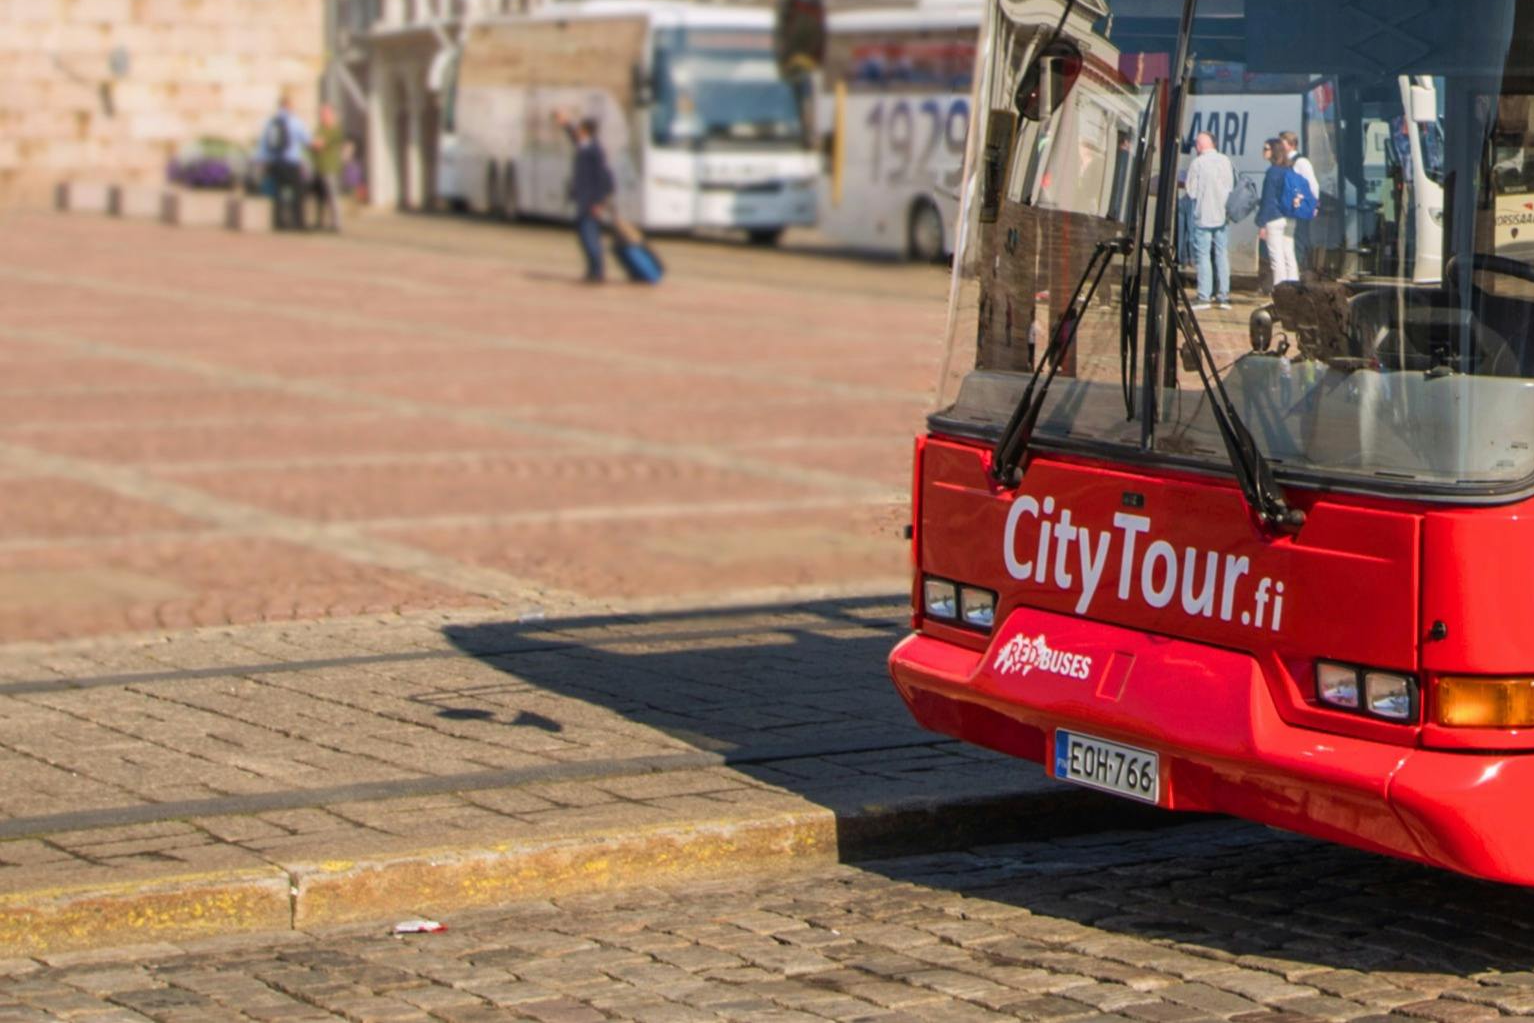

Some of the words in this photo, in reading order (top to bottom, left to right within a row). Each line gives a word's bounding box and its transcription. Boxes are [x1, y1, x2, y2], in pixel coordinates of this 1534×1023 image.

[1003, 494, 1286, 632] CityTour.fi
[1039, 646, 1093, 680] BUSES
[1070, 740, 1153, 793] EOH-766
